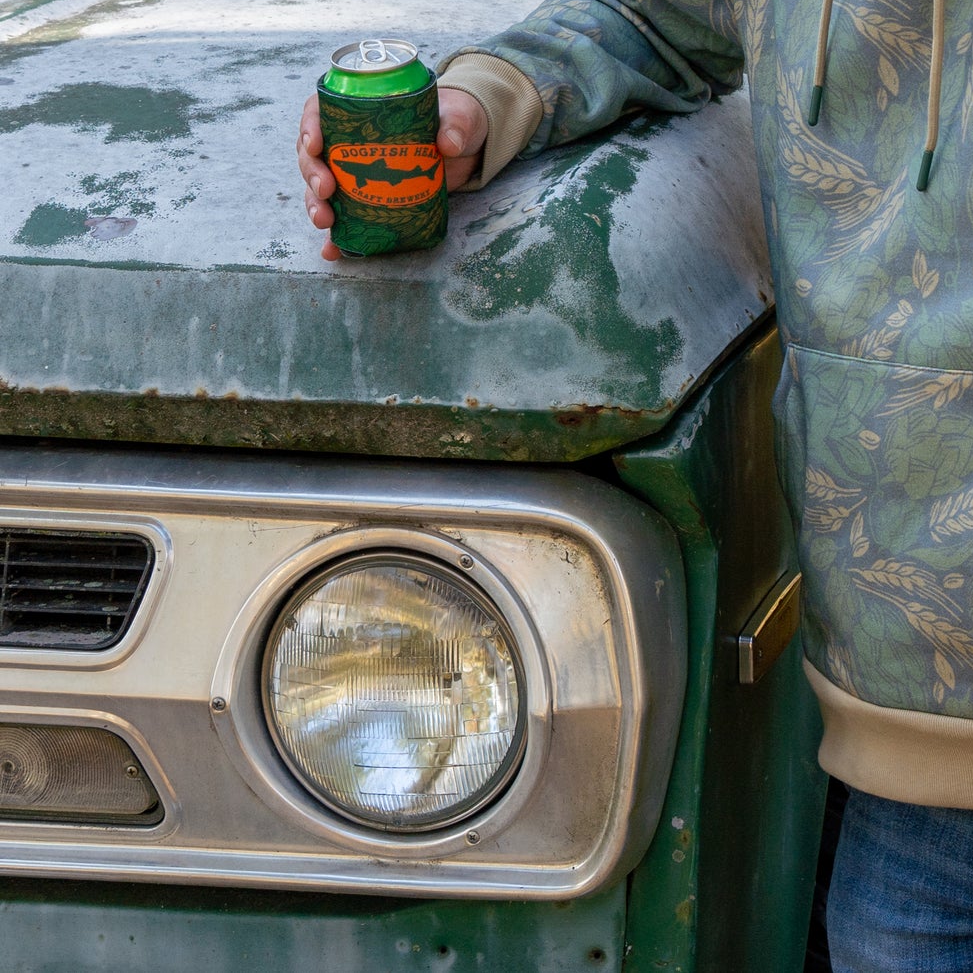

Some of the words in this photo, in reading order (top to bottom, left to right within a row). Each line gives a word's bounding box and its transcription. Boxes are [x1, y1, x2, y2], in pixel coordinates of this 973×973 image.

[340, 147, 408, 158] DOGFISH
[351, 188, 383, 203] CRAFT
[386, 189, 431, 204] BREWERY
